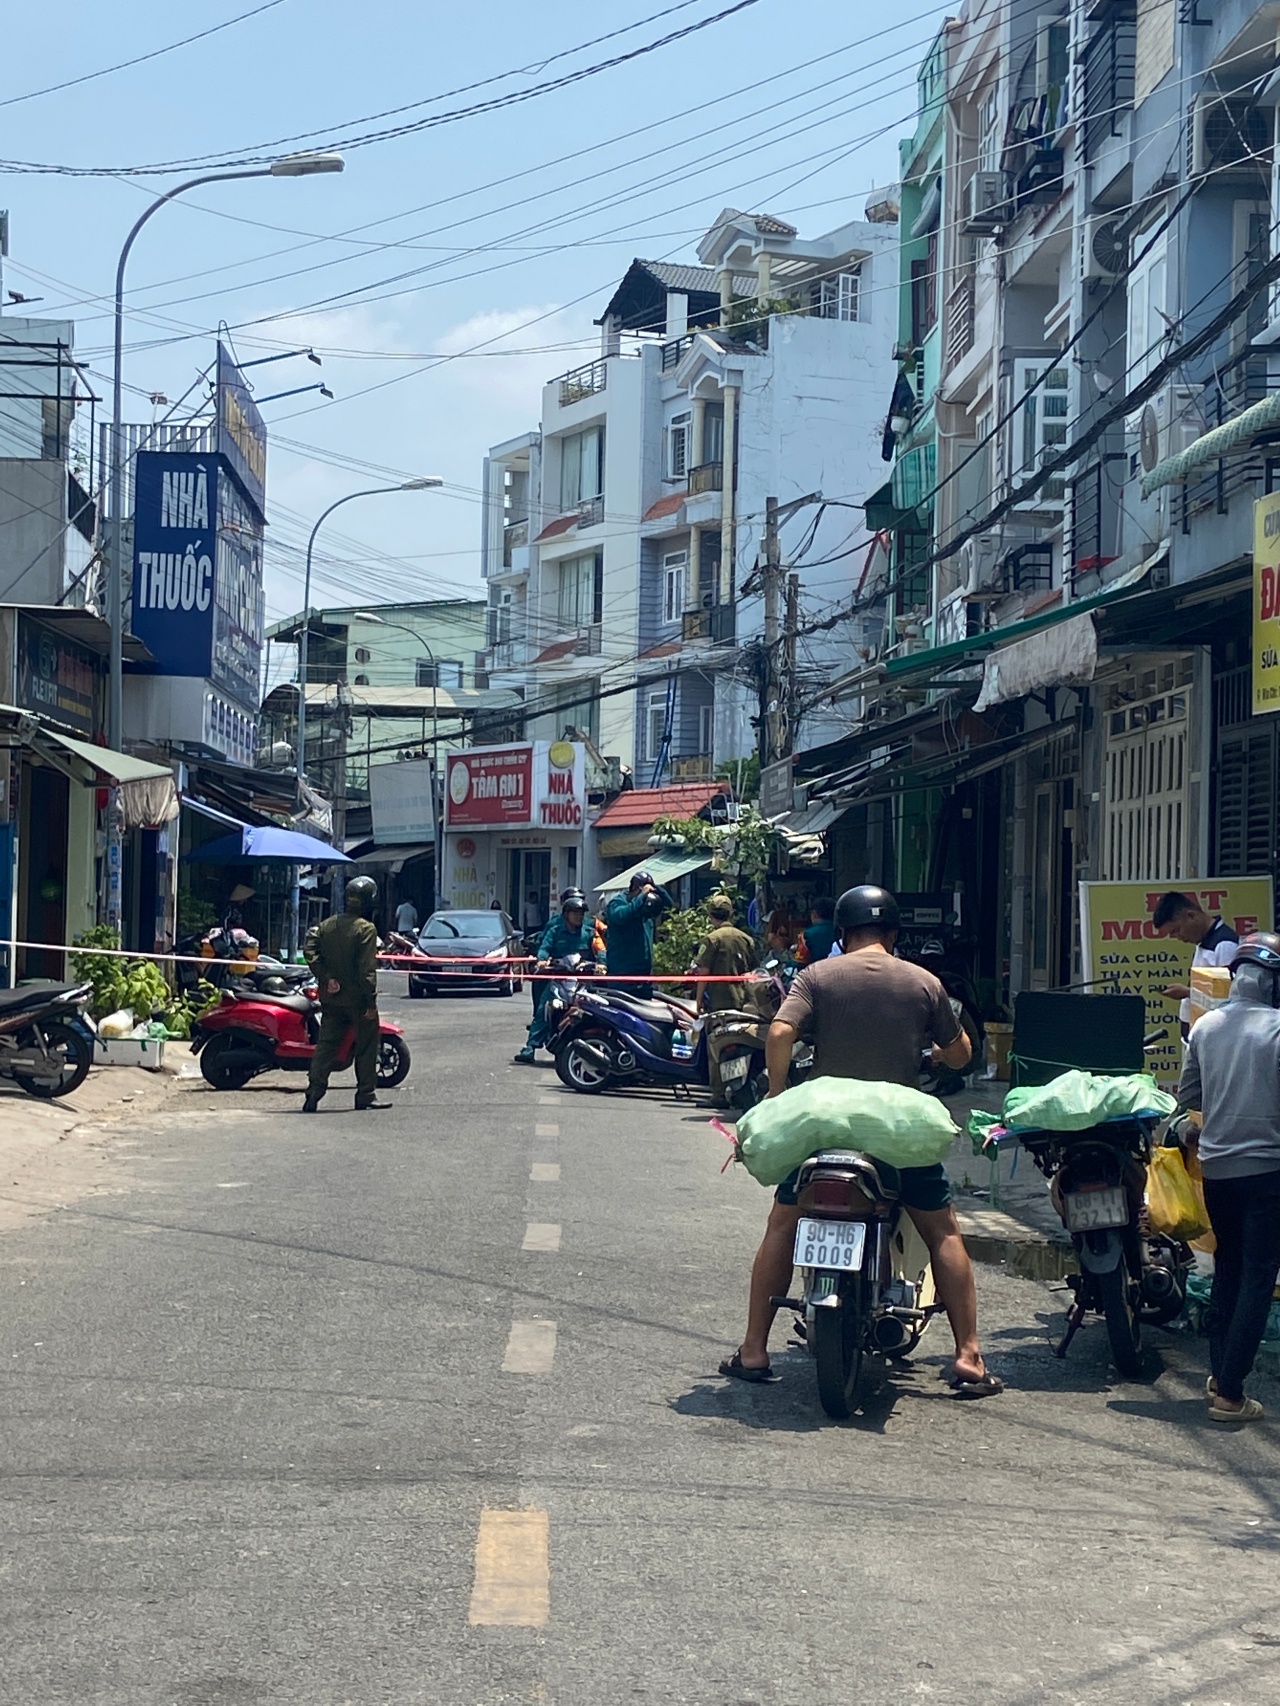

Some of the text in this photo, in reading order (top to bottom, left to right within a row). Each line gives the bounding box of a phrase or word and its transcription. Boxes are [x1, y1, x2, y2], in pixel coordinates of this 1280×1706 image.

[161, 463, 209, 529] NHÀ
[139, 540, 212, 612] THUỐC
[471, 769, 525, 799] TÂM AN 1
[549, 769, 574, 795] NHÀ
[540, 797, 582, 825] THUỐC
[453, 862, 478, 883] NHÀ
[1101, 916, 1259, 942] MOE
[1100, 952, 1130, 965] SỬA
[1135, 951, 1179, 964] CHỮA
[1101, 966, 1183, 980] THAY MÀN
[1150, 1059, 1181, 1071] RÚT
[807, 1223, 856, 1245] 90-H6
[804, 1244, 853, 1266] 6009
